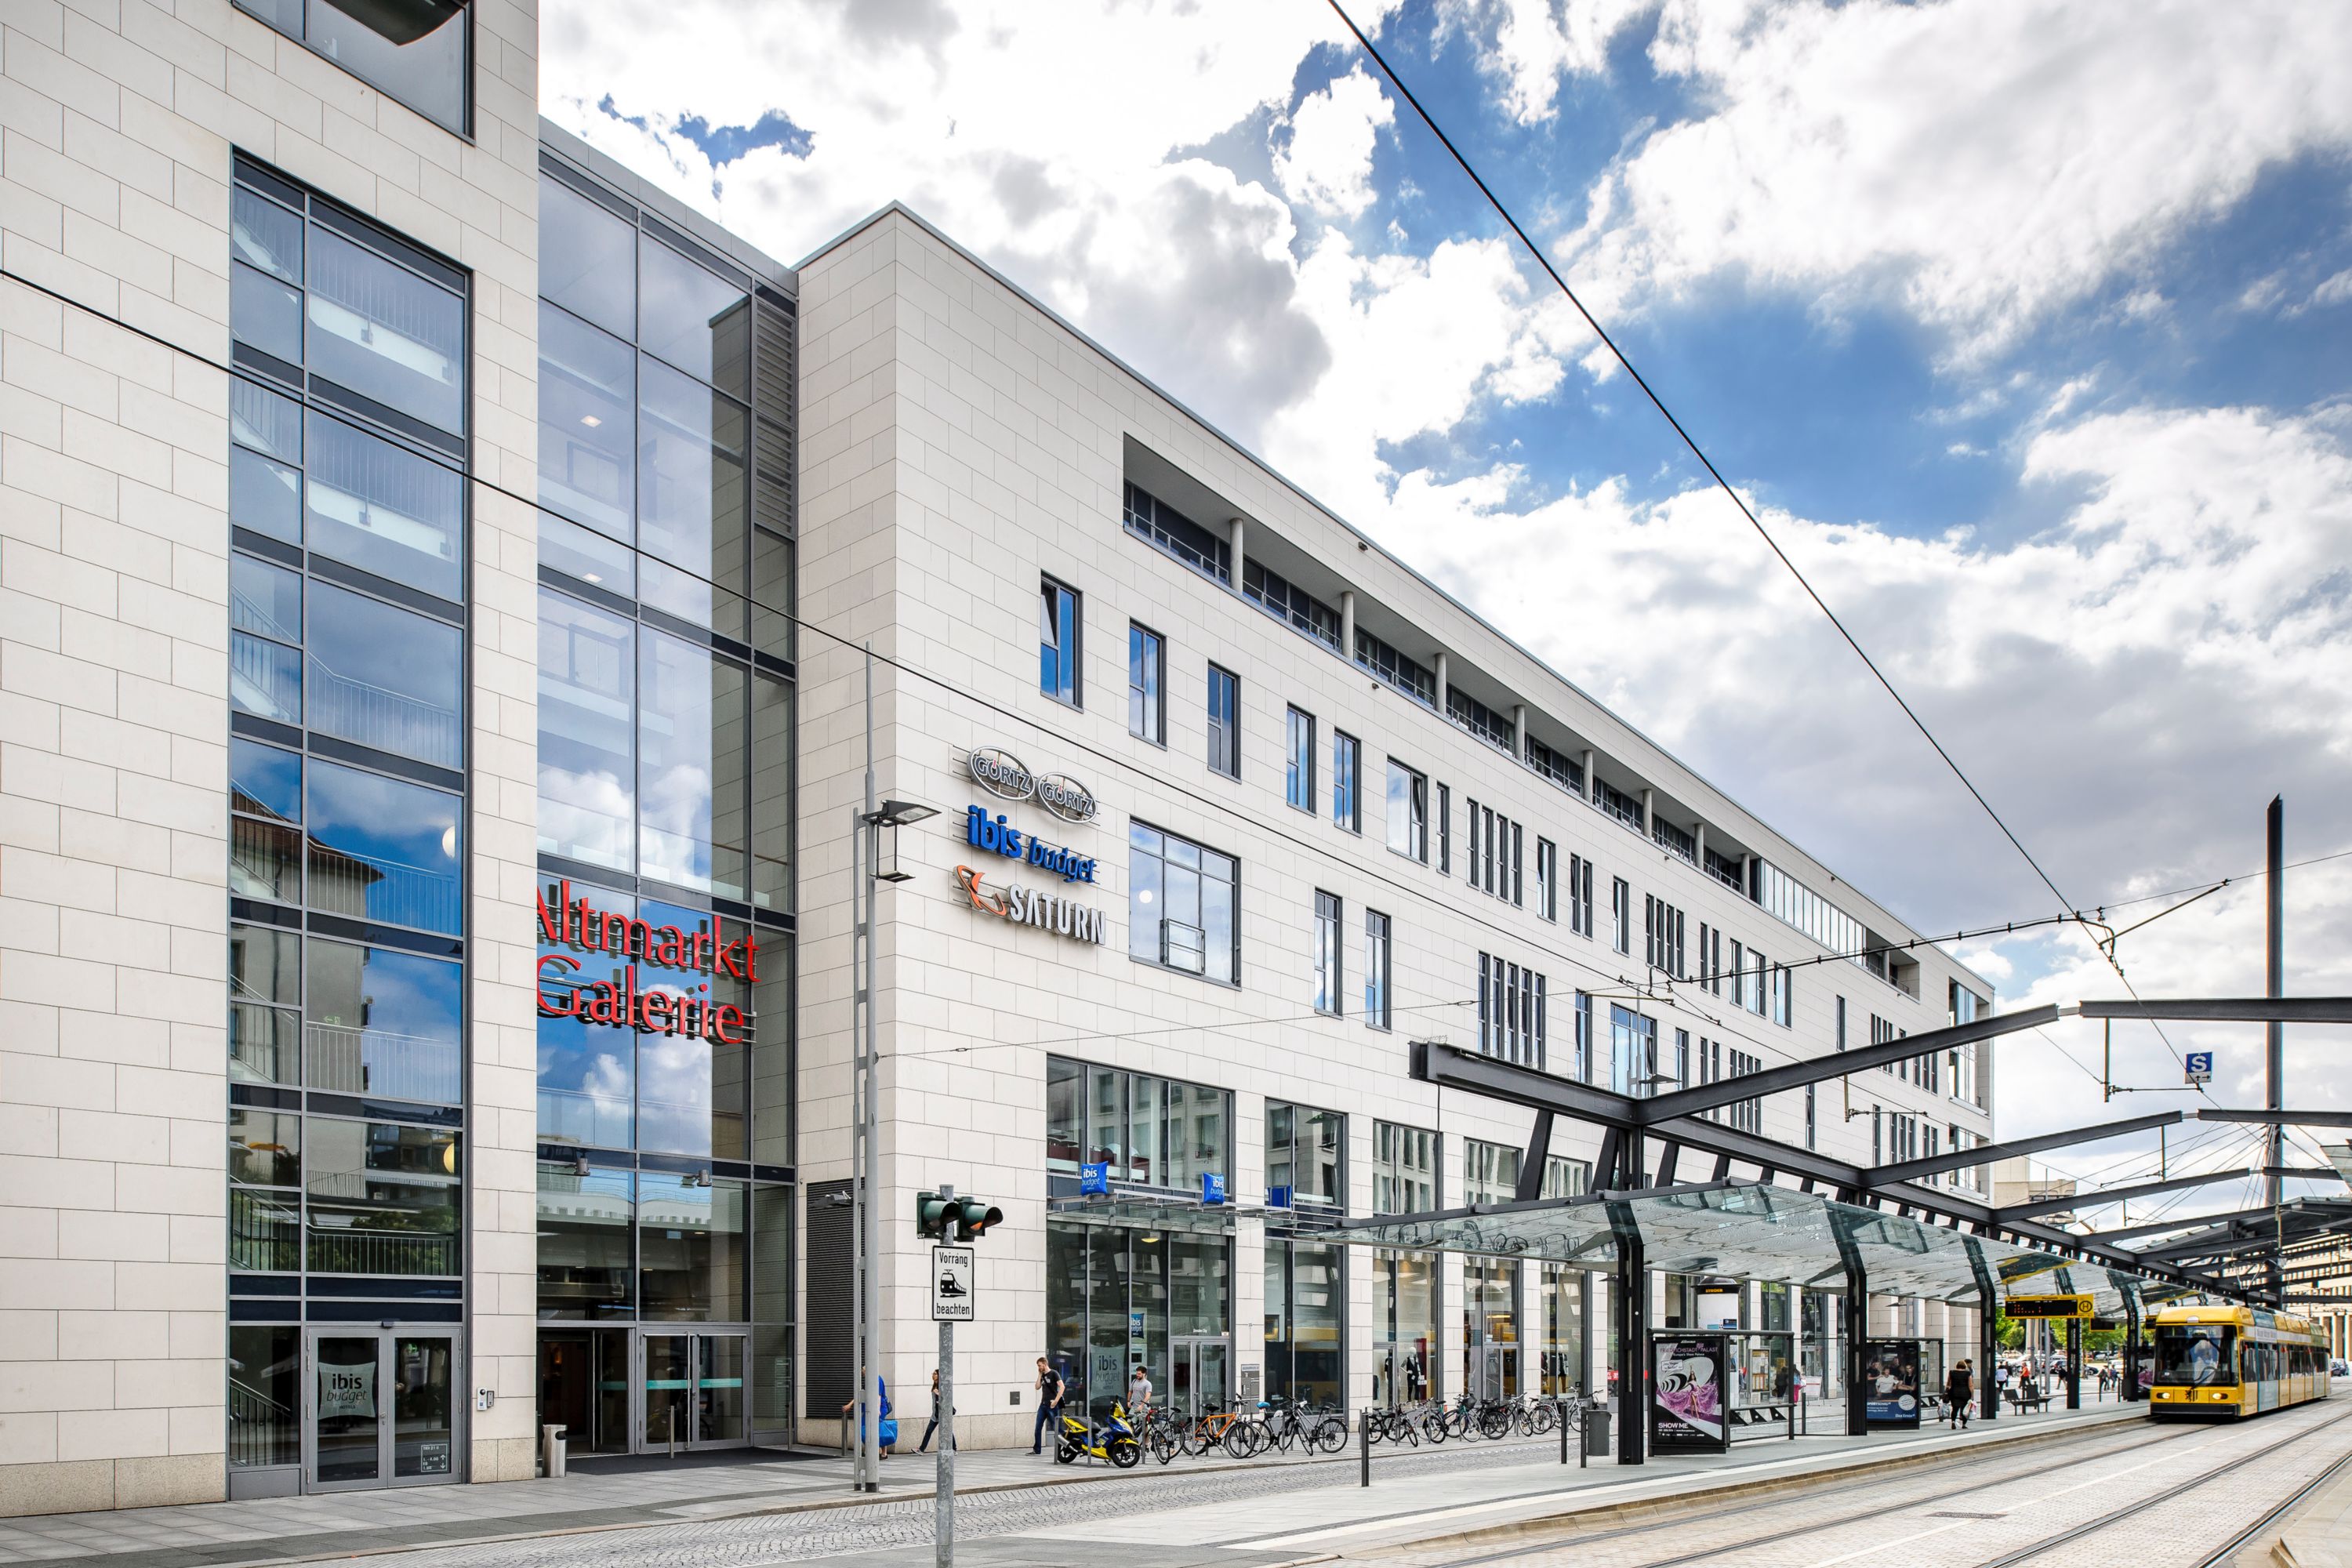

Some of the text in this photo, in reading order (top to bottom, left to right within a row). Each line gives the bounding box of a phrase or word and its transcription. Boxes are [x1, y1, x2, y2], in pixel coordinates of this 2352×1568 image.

[967, 804, 1098, 884] ibis budget
[1007, 883, 1106, 946] SATURN
[537, 953, 746, 1044] Galerie
[2190, 1055, 2209, 1073] S
[1083, 1167, 1098, 1178] ibis
[938, 1251, 968, 1268] Vorrang
[936, 1302, 970, 1316] beachten
[1098, 1355, 1118, 1371] ibis
[332, 1373, 362, 1390] ibis
[1095, 1370, 1120, 1385] budget
[326, 1389, 368, 1403] budget
